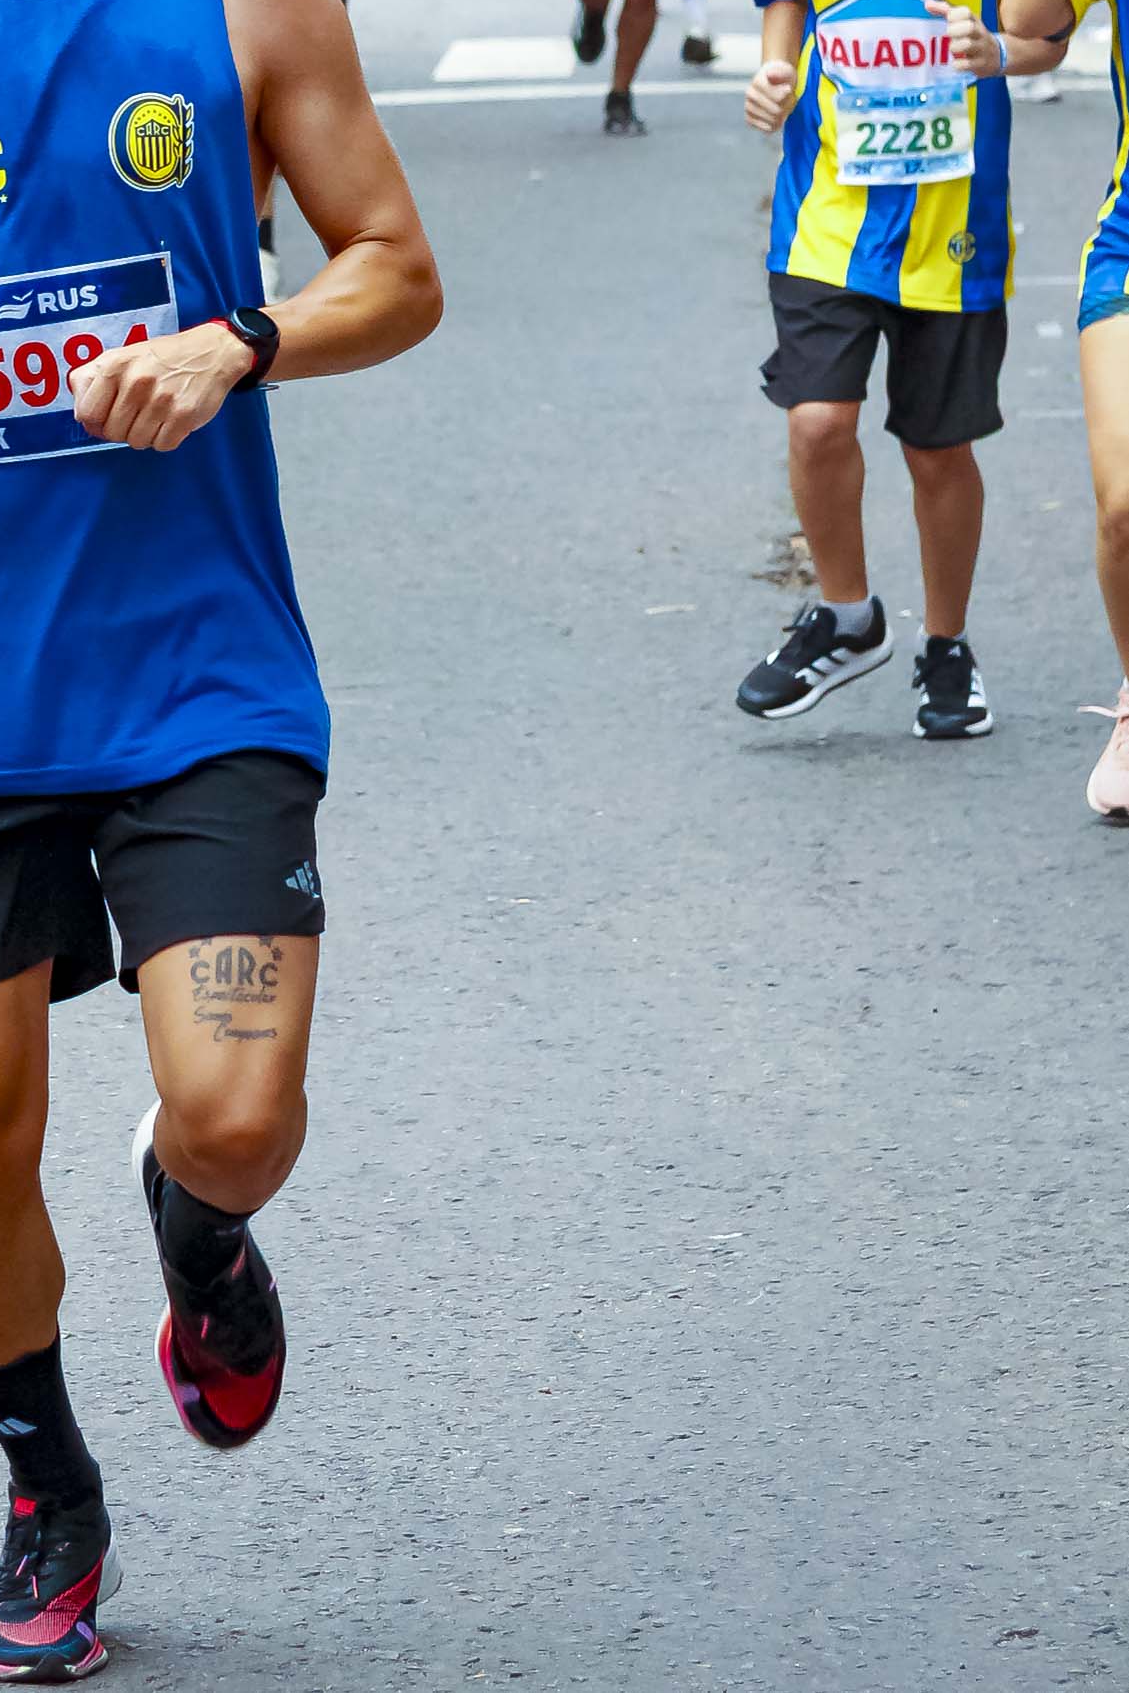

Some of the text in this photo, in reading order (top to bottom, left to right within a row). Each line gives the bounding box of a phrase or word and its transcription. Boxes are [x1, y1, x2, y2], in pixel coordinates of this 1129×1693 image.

[135, 121, 170, 136] CARC
[856, 116, 953, 156] 2228
[37, 285, 99, 315] RUS
[190, 945, 279, 987] CARC
